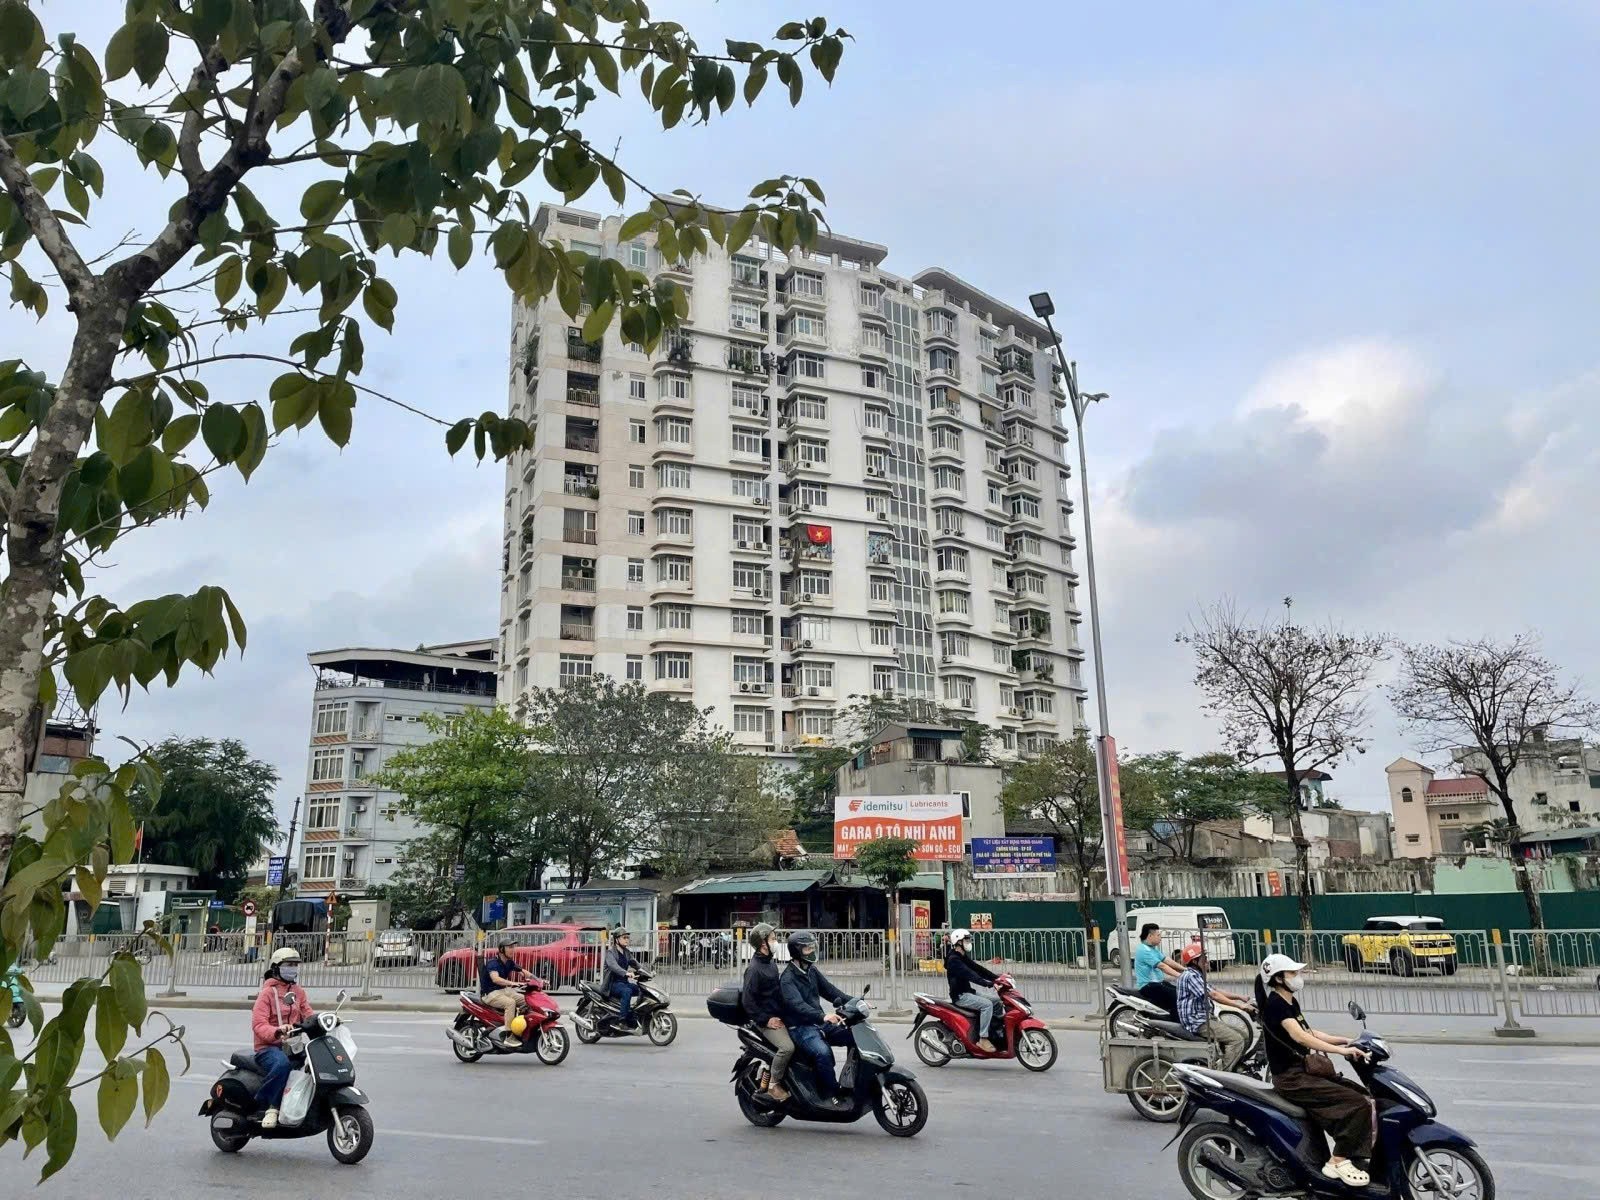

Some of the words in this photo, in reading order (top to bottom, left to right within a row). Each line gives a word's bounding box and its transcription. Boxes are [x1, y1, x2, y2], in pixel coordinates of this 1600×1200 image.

[864, 800, 903, 811] idemitsu
[841, 826, 872, 840] GARA
[876, 824, 882, 839] Ô
[886, 824, 900, 839] TÔ
[930, 826, 956, 840] ANH
[948, 844, 960, 853] ECU
[916, 912, 928, 928] PHỞ
